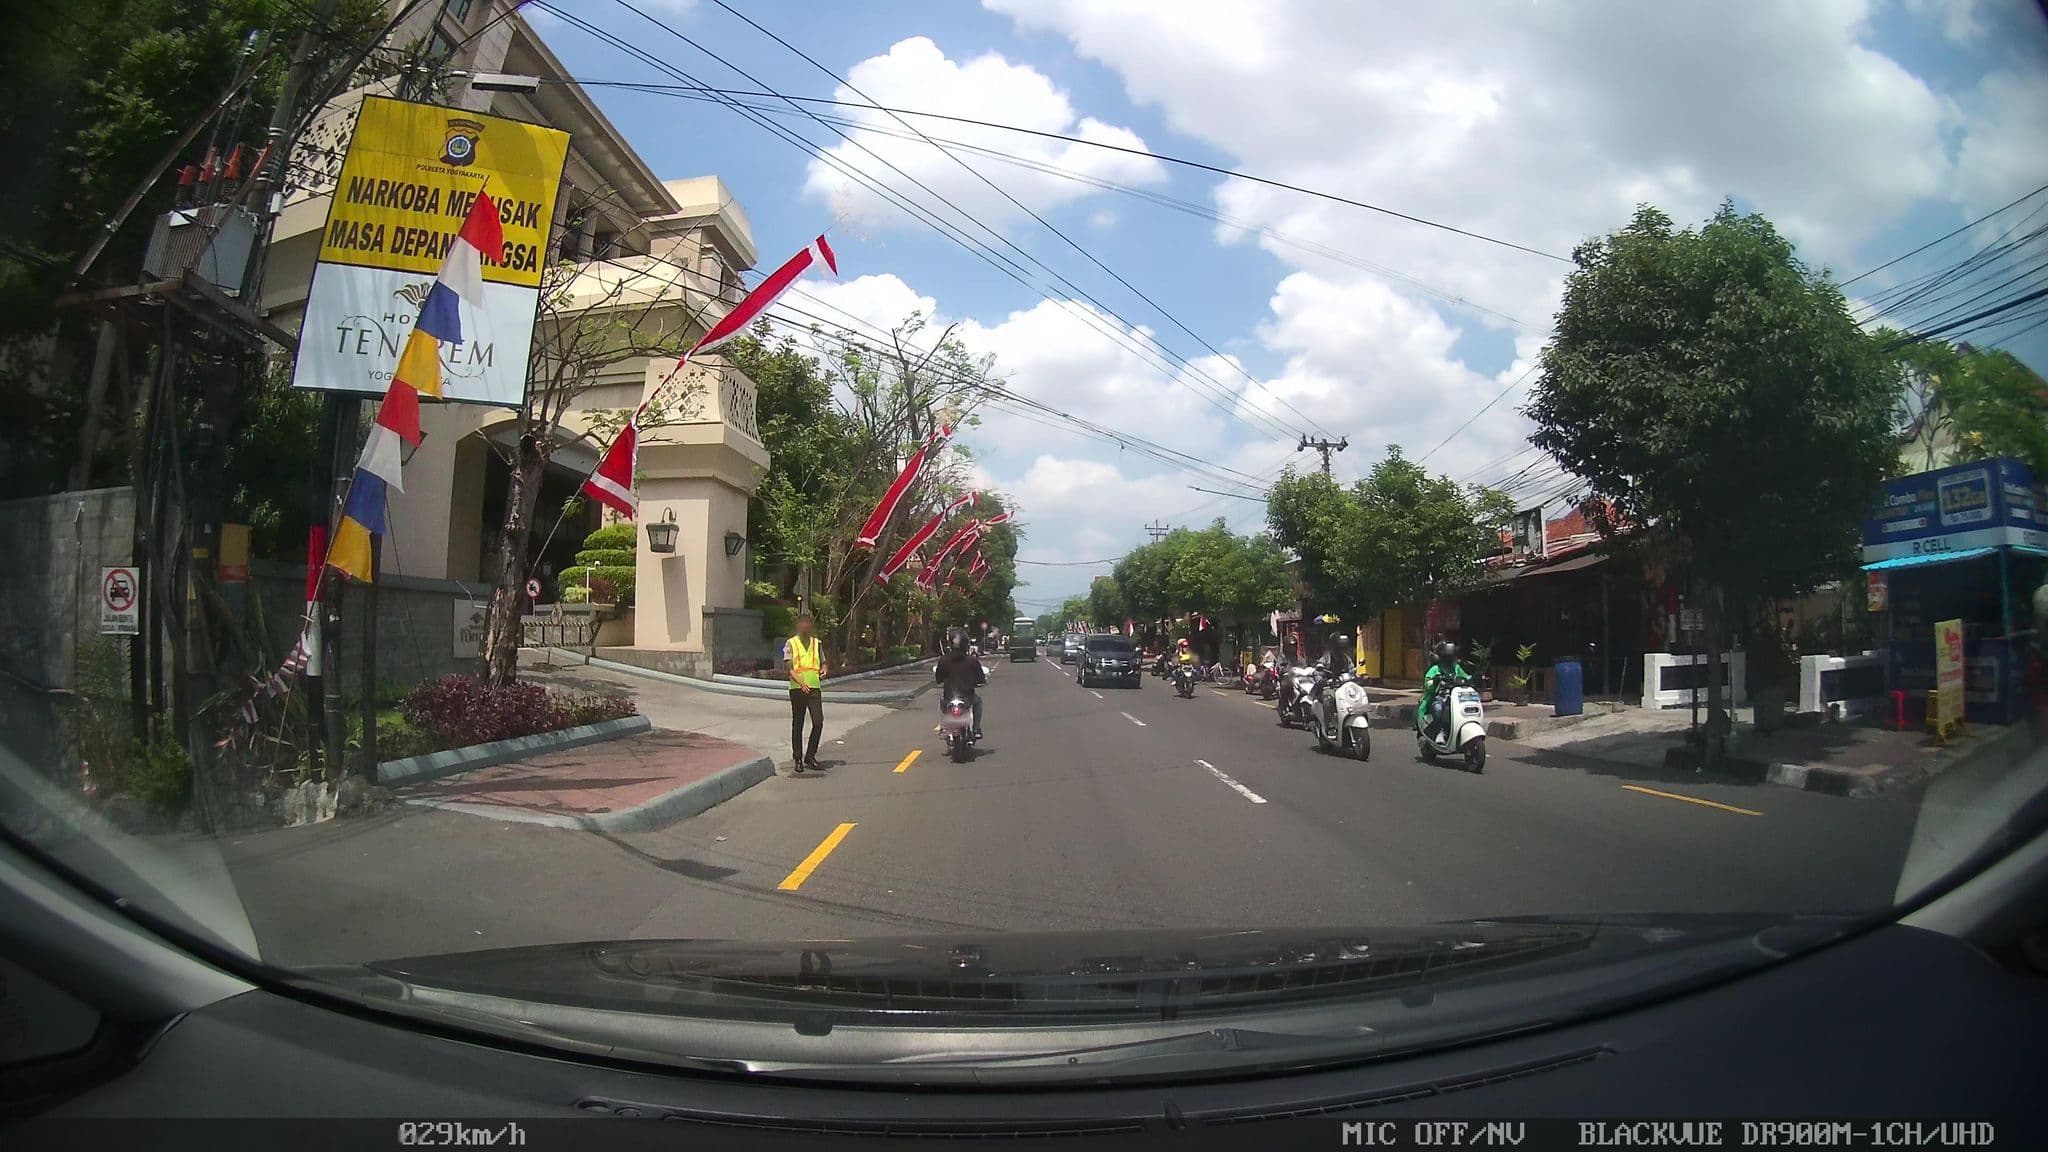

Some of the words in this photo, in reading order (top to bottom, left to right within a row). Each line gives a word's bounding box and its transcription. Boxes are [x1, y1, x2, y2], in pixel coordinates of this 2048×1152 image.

[416, 163, 446, 174] POLRESTA
[446, 168, 485, 180] YOGYAKARTA
[346, 176, 440, 214] NARKOBA
[445, 190, 542, 229] MESAK
[327, 219, 384, 253] MASA
[390, 226, 457, 260] DEPAN
[336, 316, 494, 376] TENEM
